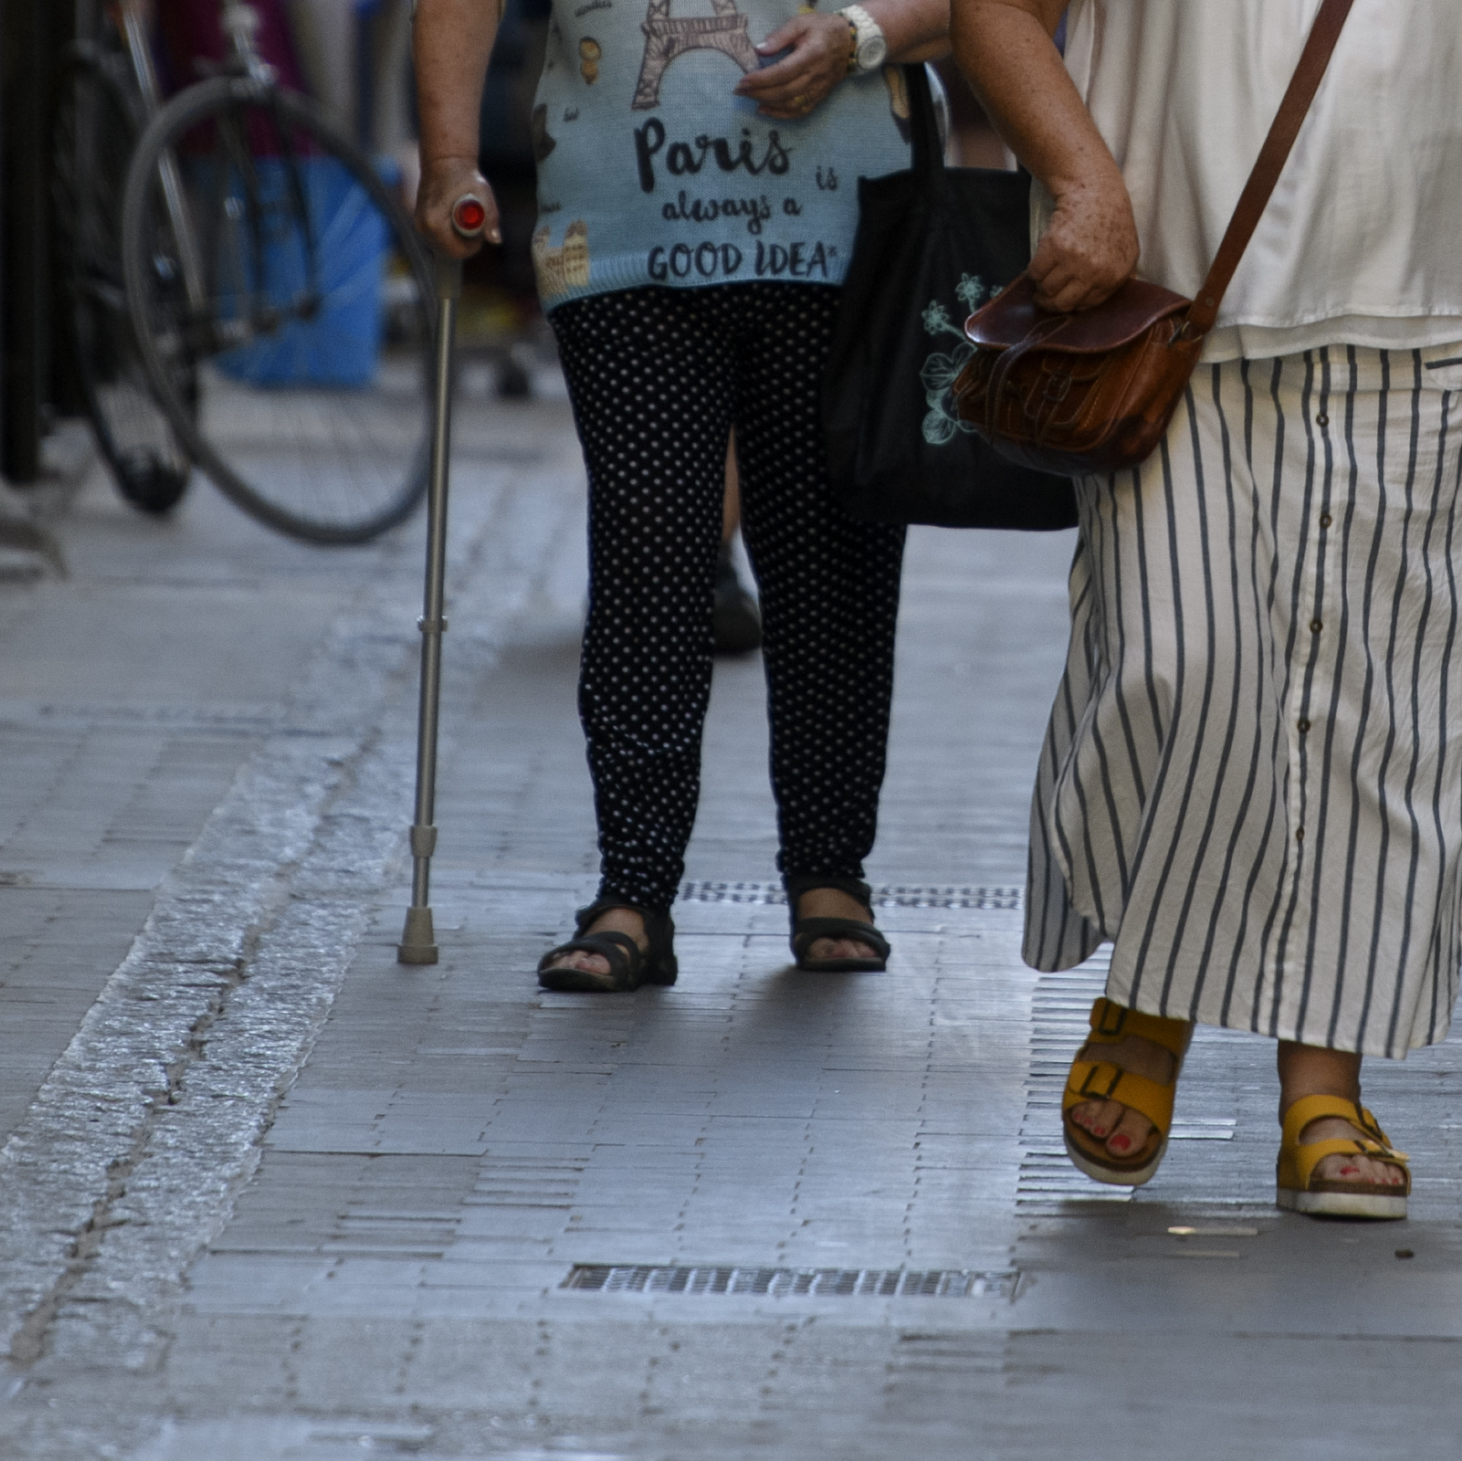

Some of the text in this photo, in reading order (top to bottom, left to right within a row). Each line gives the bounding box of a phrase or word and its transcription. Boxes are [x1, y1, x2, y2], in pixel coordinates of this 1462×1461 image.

[633, 116, 839, 194] Paris is
[662, 190, 802, 235] always a
[647, 240, 743, 281] GOOD
